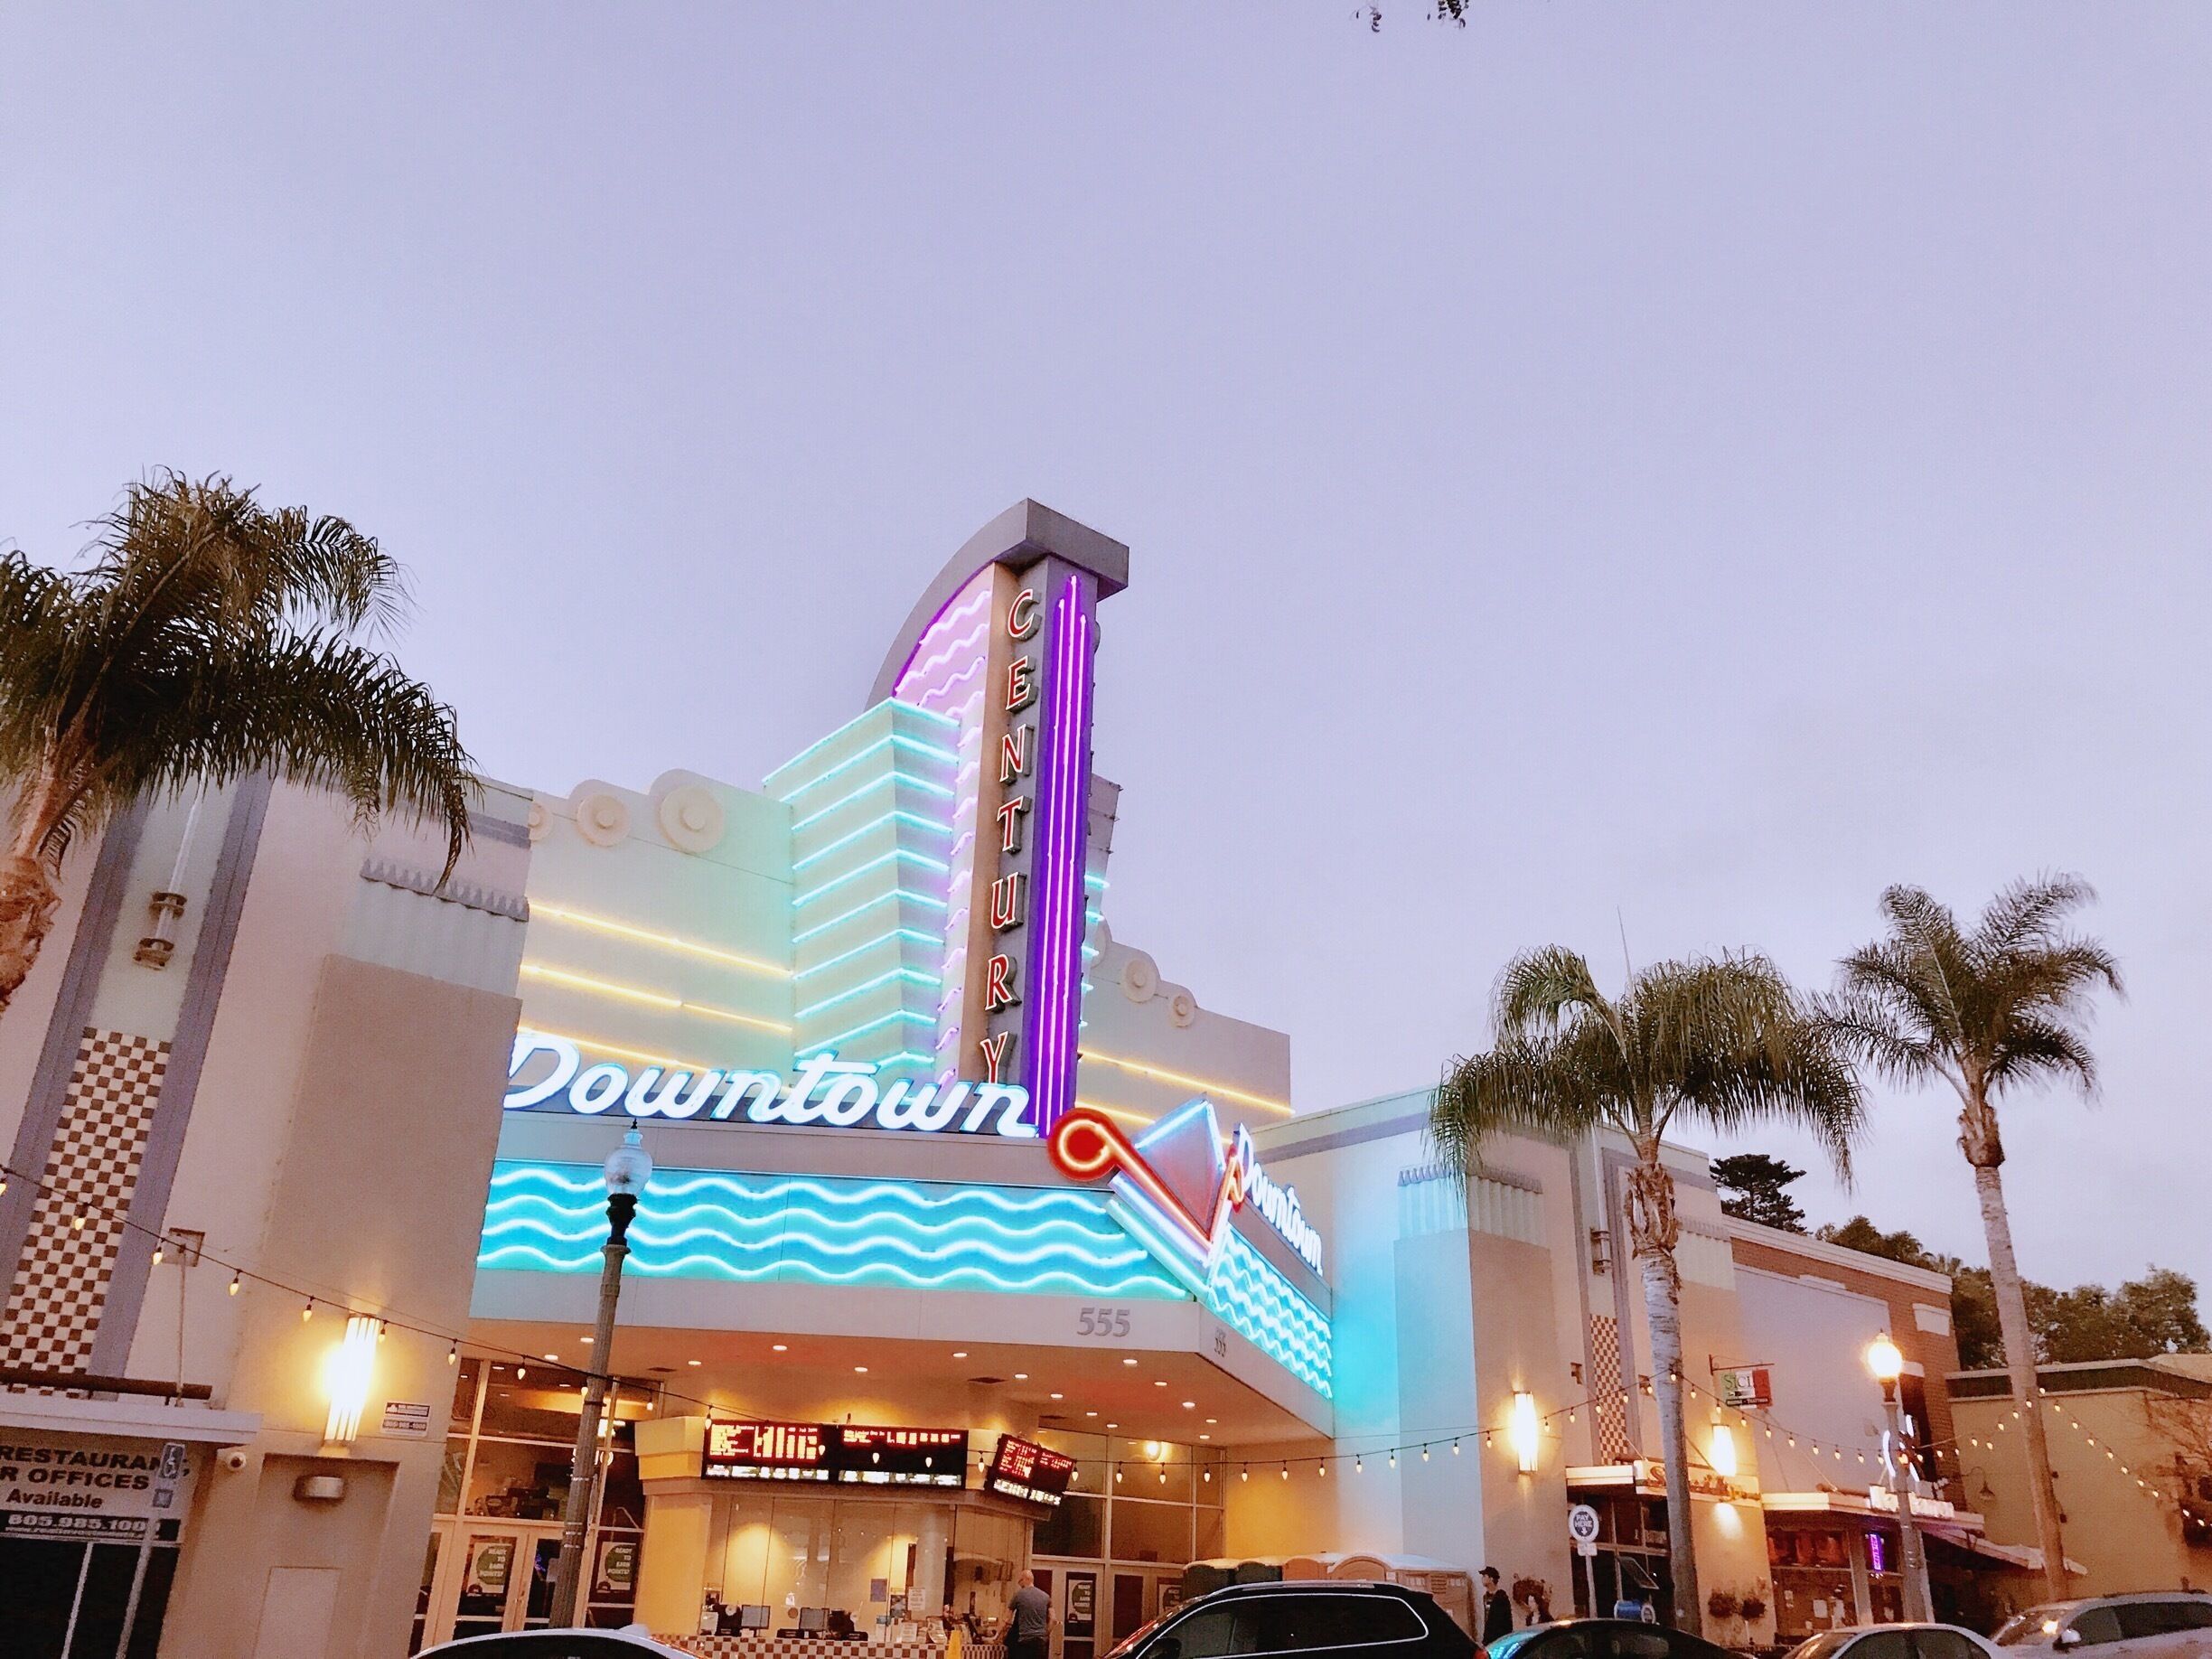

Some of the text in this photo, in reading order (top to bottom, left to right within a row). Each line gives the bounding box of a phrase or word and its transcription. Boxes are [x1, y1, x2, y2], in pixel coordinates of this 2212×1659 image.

[979, 588, 1035, 1084] CENTURY
[502, 1032, 1041, 1139] Downtown
[1240, 1122, 1323, 1277] Downtown
[1076, 1307, 1131, 1337] 555
[28, 1468, 149, 1490] OFFICES
[6, 1488, 103, 1508] Available
[8, 1514, 161, 1532] 805.985.100
